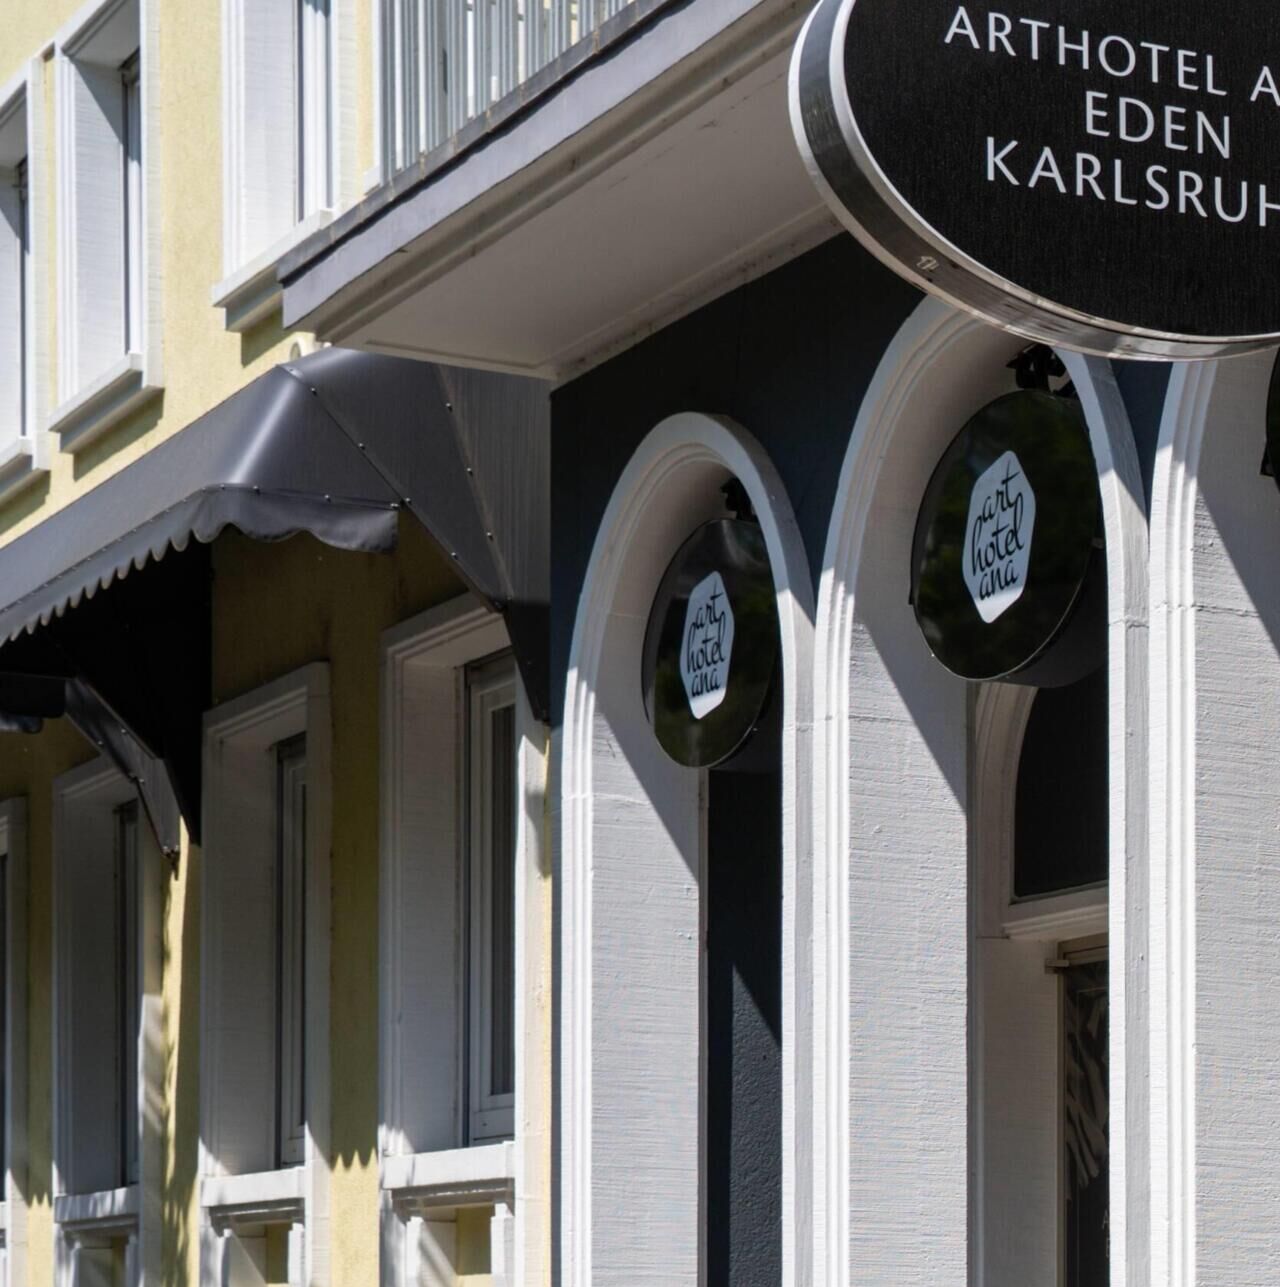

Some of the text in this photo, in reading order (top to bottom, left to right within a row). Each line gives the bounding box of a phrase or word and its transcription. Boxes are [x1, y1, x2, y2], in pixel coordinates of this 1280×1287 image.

[944, 6, 1227, 96] ARTHOTEL
[1085, 90, 1230, 159] EDEN
[982, 460, 1020, 523] art
[971, 492, 1025, 576] hotel
[695, 582, 724, 629] art
[979, 560, 1020, 600] ana
[687, 610, 726, 673] hotel
[691, 667, 721, 697] ana
